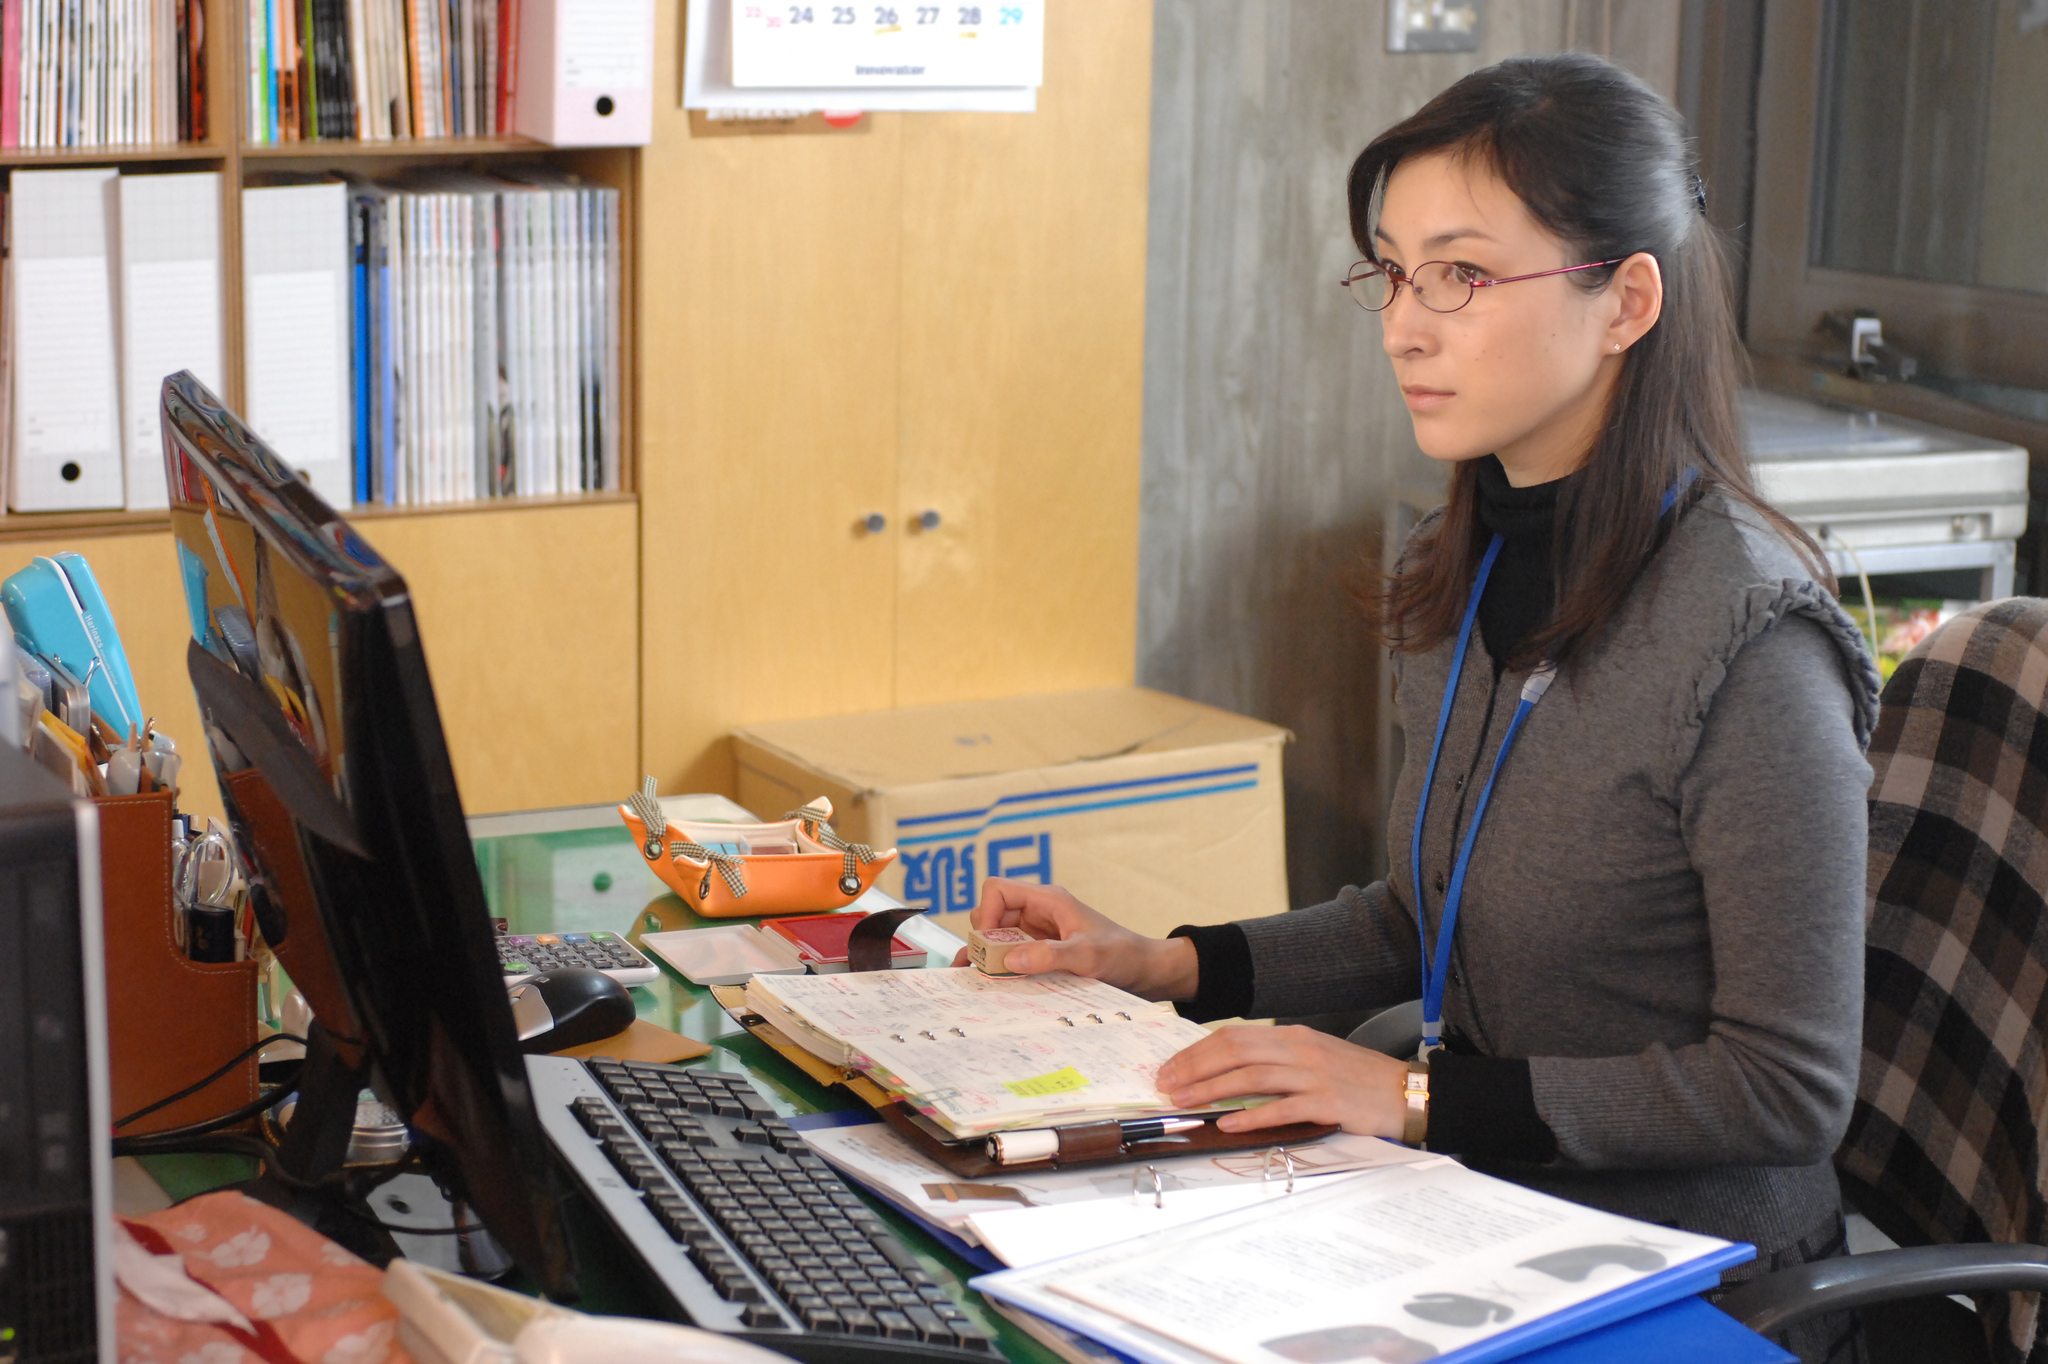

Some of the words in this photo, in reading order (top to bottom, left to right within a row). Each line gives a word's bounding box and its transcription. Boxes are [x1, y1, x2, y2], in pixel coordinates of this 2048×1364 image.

[788, 5, 814, 25] 24
[831, 5, 856, 25] 25
[873, 6, 899, 25] 26
[916, 6, 940, 25] 27
[957, 6, 982, 25] 28
[999, 6, 1024, 25] 29
[84, 614, 104, 649] Harinacs
